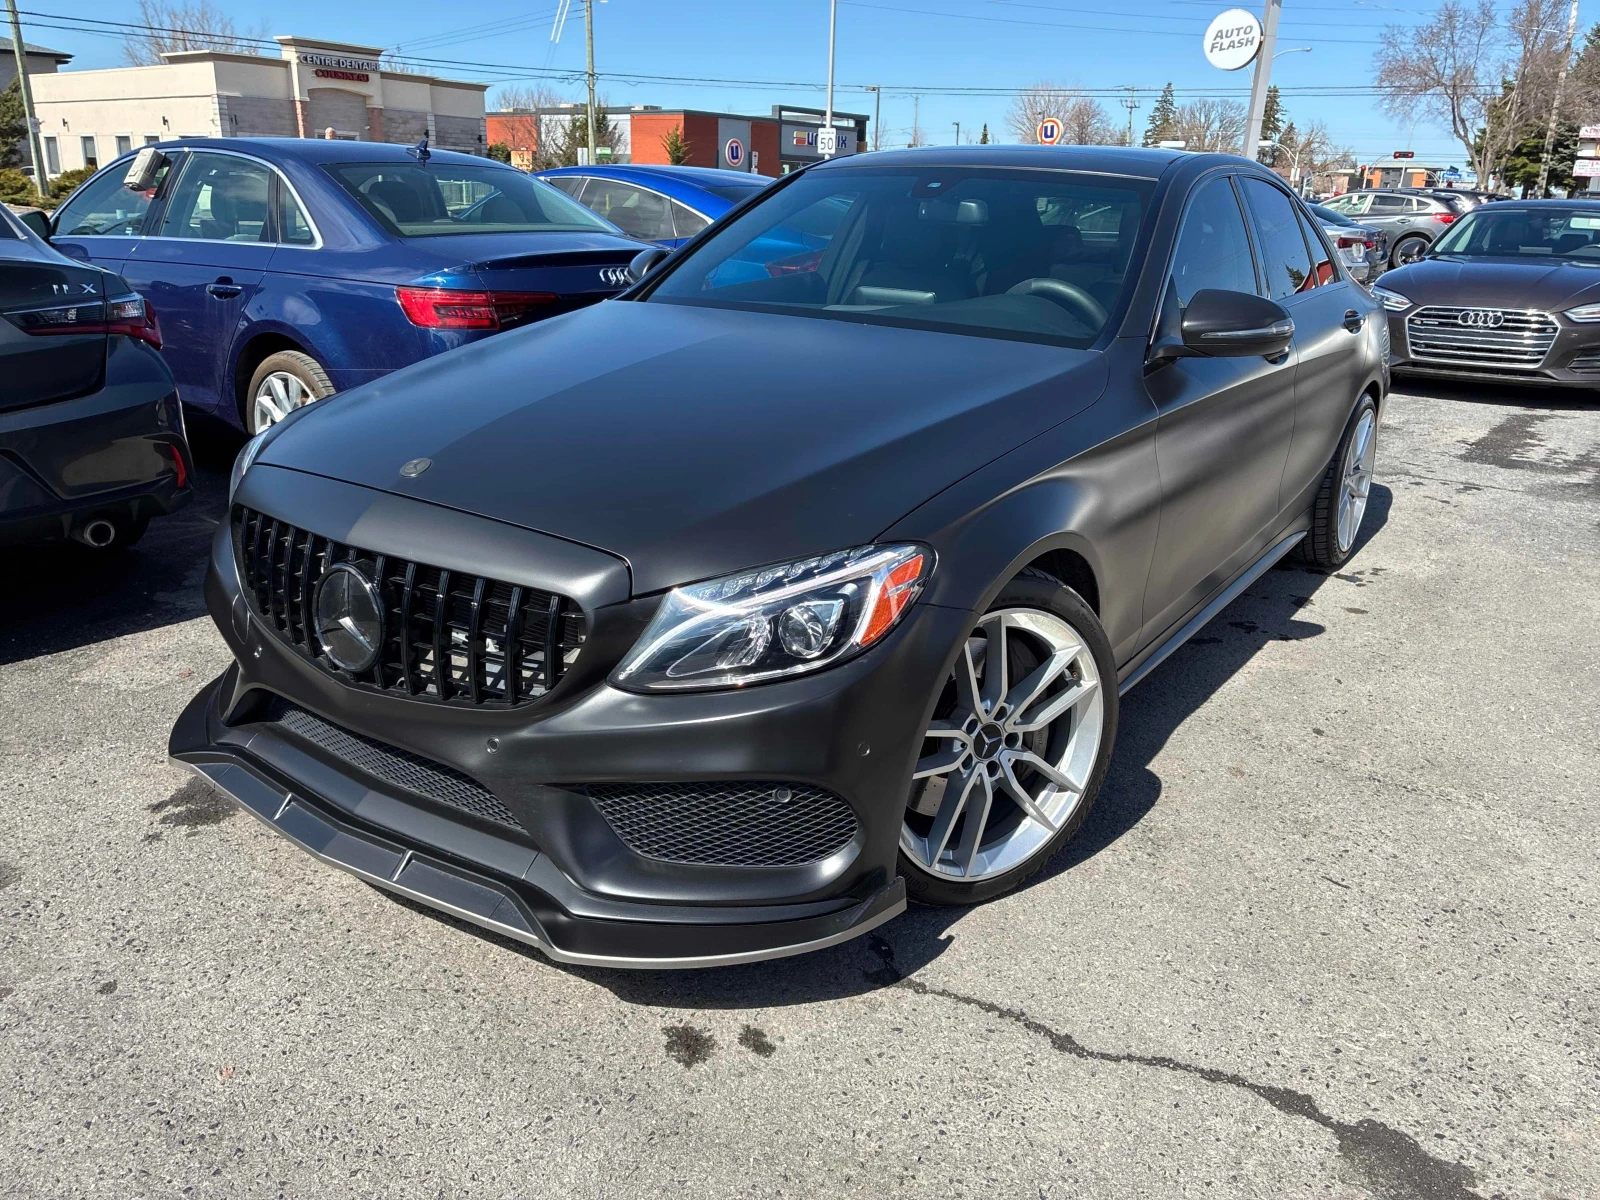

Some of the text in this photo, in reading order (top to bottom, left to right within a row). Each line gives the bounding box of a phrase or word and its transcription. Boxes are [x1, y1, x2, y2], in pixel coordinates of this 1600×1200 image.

[1213, 25, 1253, 41] AUTO
[1210, 36, 1255, 53] FLASH
[300, 54, 380, 72] CENTRE DENTAIRE
[820, 137, 834, 150] 50
